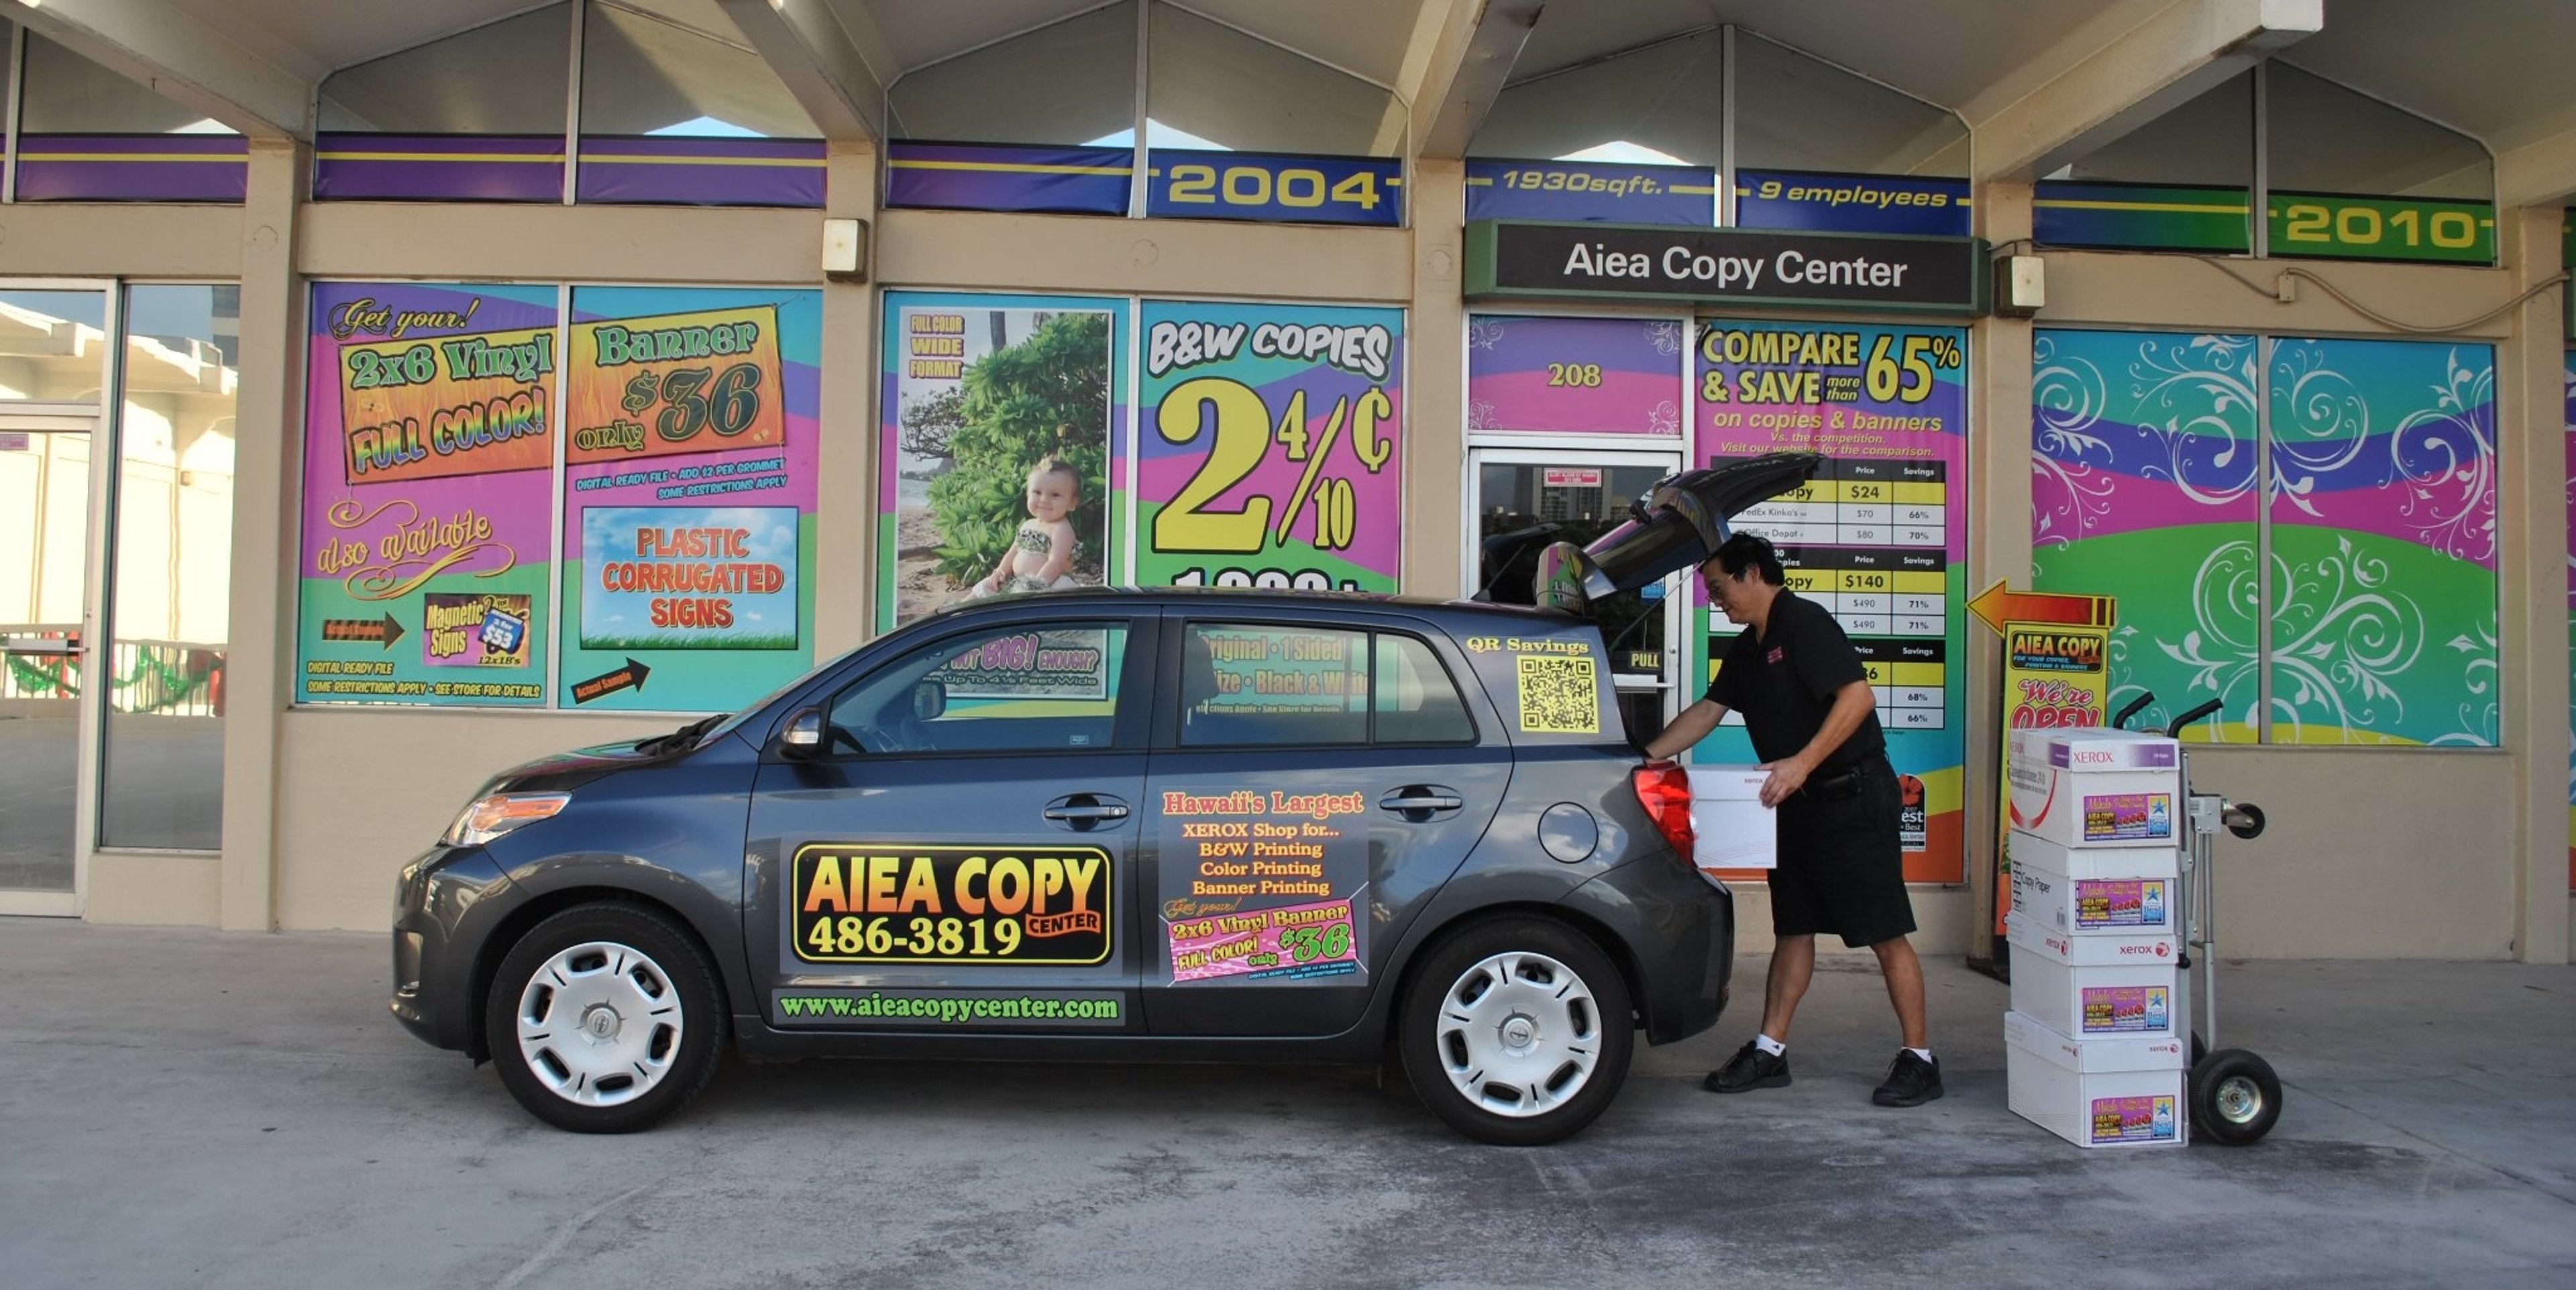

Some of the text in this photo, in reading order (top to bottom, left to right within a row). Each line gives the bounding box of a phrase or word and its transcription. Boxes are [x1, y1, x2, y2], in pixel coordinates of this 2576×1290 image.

[1169, 165, 1380, 209] 2004
[1502, 170, 1664, 197] 1930sqft.
[1758, 182, 1947, 209] 9 employees
[2286, 204, 2476, 249] 2010
[1564, 243, 1908, 290] Aiea Copy Center
[329, 298, 480, 340] Get your!
[910, 314, 965, 334] FULL COLOR
[594, 321, 759, 367] Banner
[910, 337, 964, 356] WIDE
[1147, 321, 1392, 381] B&W COPIES
[1701, 331, 1860, 366] COMPARE
[349, 333, 553, 390] 2x6 Vinyl
[909, 360, 964, 378] FORMAT
[1865, 335, 1961, 402] 65%
[1547, 363, 1602, 387] 208
[1827, 376, 1860, 389] more
[1701, 370, 1821, 405] & SAVE
[1825, 388, 1858, 402] than
[621, 362, 761, 442] $36
[351, 386, 546, 476] FULL COLOR!
[1713, 411, 1943, 432] on copies & banners
[574, 419, 645, 451] only
[1770, 432, 1886, 445] Vs. the competition.
[1721, 442, 1746, 452] Visit
[1750, 444, 1769, 453] our
[1821, 443, 1838, 454] for
[1841, 445, 1860, 455] the
[1862, 446, 1935, 457] comparison.
[576, 477, 613, 492] DIGITAL
[615, 474, 647, 487] READY
[649, 471, 669, 484] FILE
[678, 467, 699, 480] ADD
[715, 464, 735, 476] PER
[736, 458, 786, 474] GROMMET
[1904, 468, 1935, 476] Savings
[657, 475, 787, 500] SOME RESTRICTIONS APPLY
[1780, 486, 1879, 500] opy $24
[1768, 508, 1798, 516] Kinko's
[1857, 510, 1929, 519] $70 66%
[317, 508, 492, 574] also available
[636, 527, 751, 558] PLASTIC
[1744, 529, 1769, 537] Office
[1857, 531, 1929, 540] $80 70%
[1855, 556, 1934, 566] Price Savings
[602, 561, 784, 593] CORRUGATED
[1785, 575, 1884, 590] opy $140
[426, 601, 484, 630] Magnetic
[650, 598, 734, 628] SIGNS
[1854, 600, 1929, 608] $490 71%
[1854, 621, 1929, 629] $490 71%
[431, 629, 467, 657] Signs
[483, 625, 513, 649] $53
[1201, 635, 1268, 662] riginal
[1293, 637, 1344, 661] Sided
[1467, 637, 1589, 655] QR Savings
[2013, 635, 2100, 657] AIEA COPY
[477, 656, 521, 665] 12x18's
[981, 634, 1039, 671] BIG!
[1038, 649, 1098, 671] ENOUGH?
[1631, 653, 1660, 667] PULL
[1902, 647, 1933, 655] Savings
[307, 661, 394, 676] DIGITAL READY FILE
[945, 675, 965, 684] Up
[968, 675, 985, 684] To
[1020, 676, 1056, 684] Feet
[1057, 676, 1097, 685] Wide
[307, 680, 541, 698] SOME RESTRICTIONS APPLY SEE STORE FOR DETAILS
[1214, 669, 1320, 695] ize Black &
[2018, 678, 2093, 704] We're
[1908, 694, 1927, 702] 68%
[1908, 714, 1927, 722] 66%
[2010, 704, 2101, 729] OPEN
[2074, 751, 2114, 763] XEROX
[1163, 791, 1364, 819] Hawaii's Largest
[1901, 811, 1923, 822] est
[1183, 824, 1340, 839] XEROX Shop for...
[1199, 843, 1324, 858] B&W Printing
[1200, 861, 1322, 877] Color Printing
[804, 856, 1100, 915] AIEA COPY
[1193, 881, 1330, 896] Banner Printing
[2021, 872, 2051, 894] Copy Paper
[1028, 913, 1098, 934] CENTER
[1173, 904, 1349, 940] 2x6 Vinyl Banner
[808, 916, 1021, 955] 486-3819
[1248, 922, 1351, 966] only $36
[1177, 936, 1258, 971] FULL COLOR!
[2119, 944, 2152, 955] xerox
[780, 991, 1118, 1022] www.aieacopycenter.com
